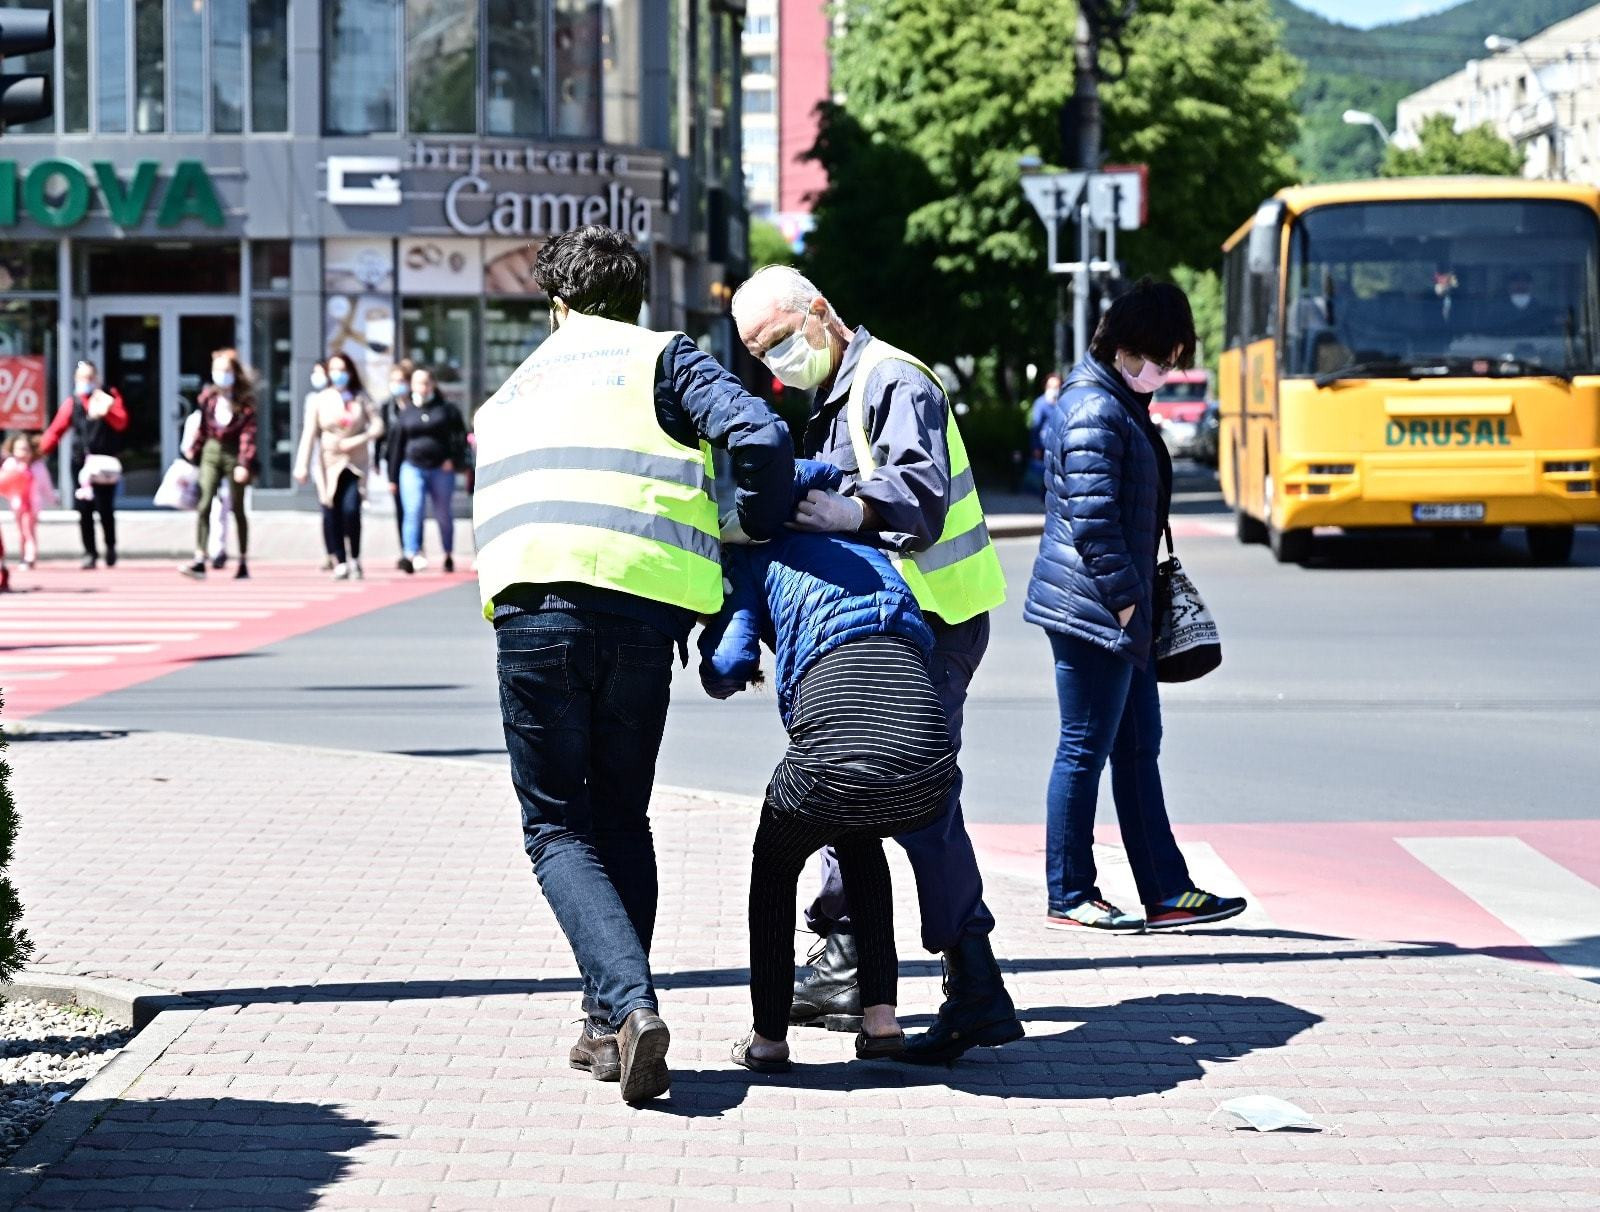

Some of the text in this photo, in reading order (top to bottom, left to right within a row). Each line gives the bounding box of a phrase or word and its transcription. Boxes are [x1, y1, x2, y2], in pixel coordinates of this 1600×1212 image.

[0, 156, 226, 229] OVA
[445, 175, 652, 241] Camelia
[1385, 418, 1511, 447] DRUSAL
